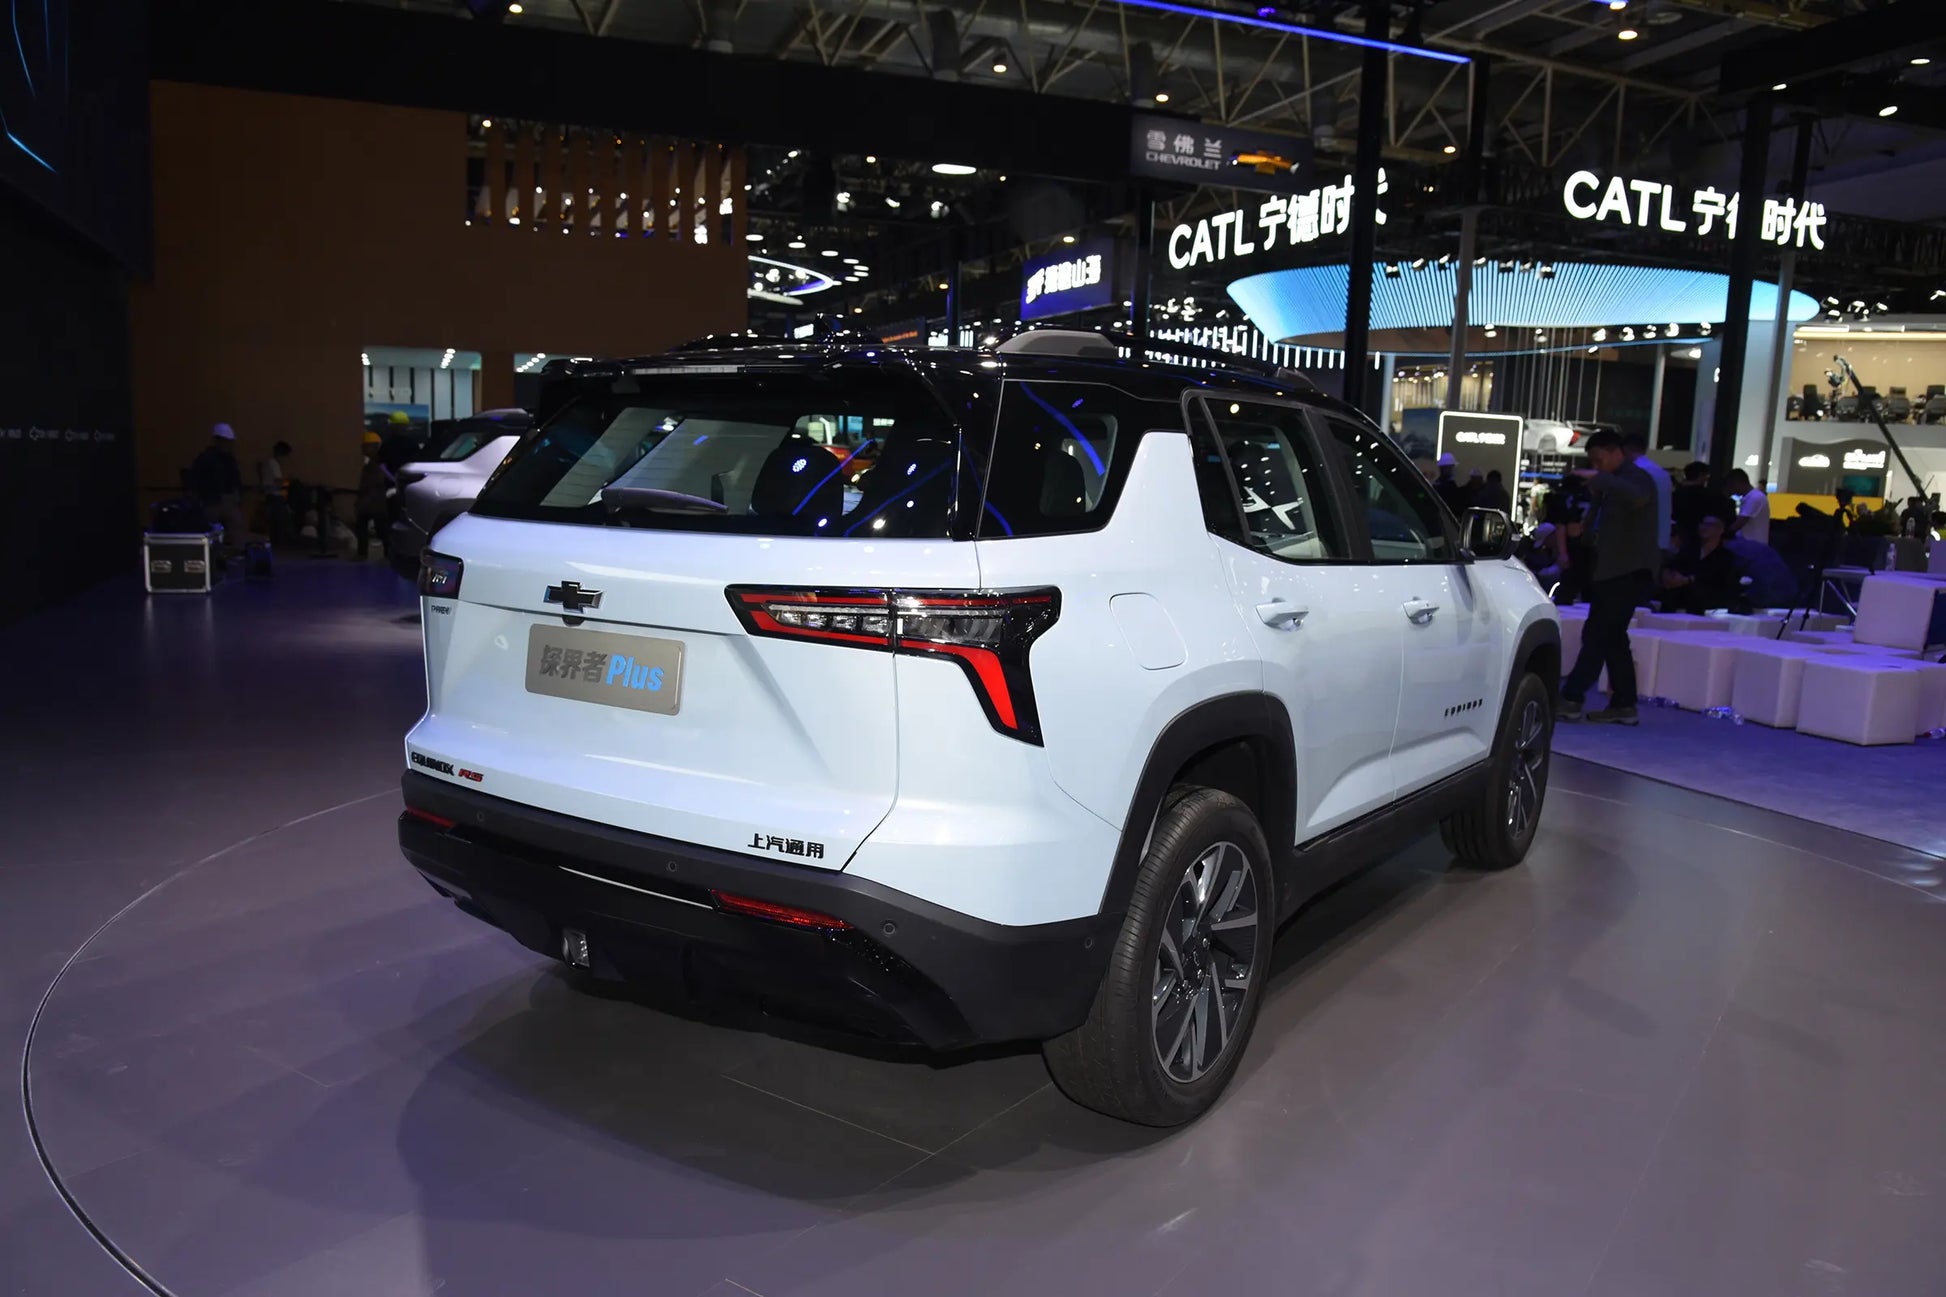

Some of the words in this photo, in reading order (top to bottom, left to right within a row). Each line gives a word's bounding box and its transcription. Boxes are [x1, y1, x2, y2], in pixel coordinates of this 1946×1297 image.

[1146, 130, 1222, 158] 雪佛兰
[1145, 151, 1221, 170] CHEVROLET
[1563, 170, 1686, 232] CATL
[1168, 209, 1254, 270] CATL
[540, 644, 607, 683] 探界者
[606, 653, 665, 692] Plus
[458, 768, 484, 782] RS
[747, 832, 825, 859] 上汽通用
